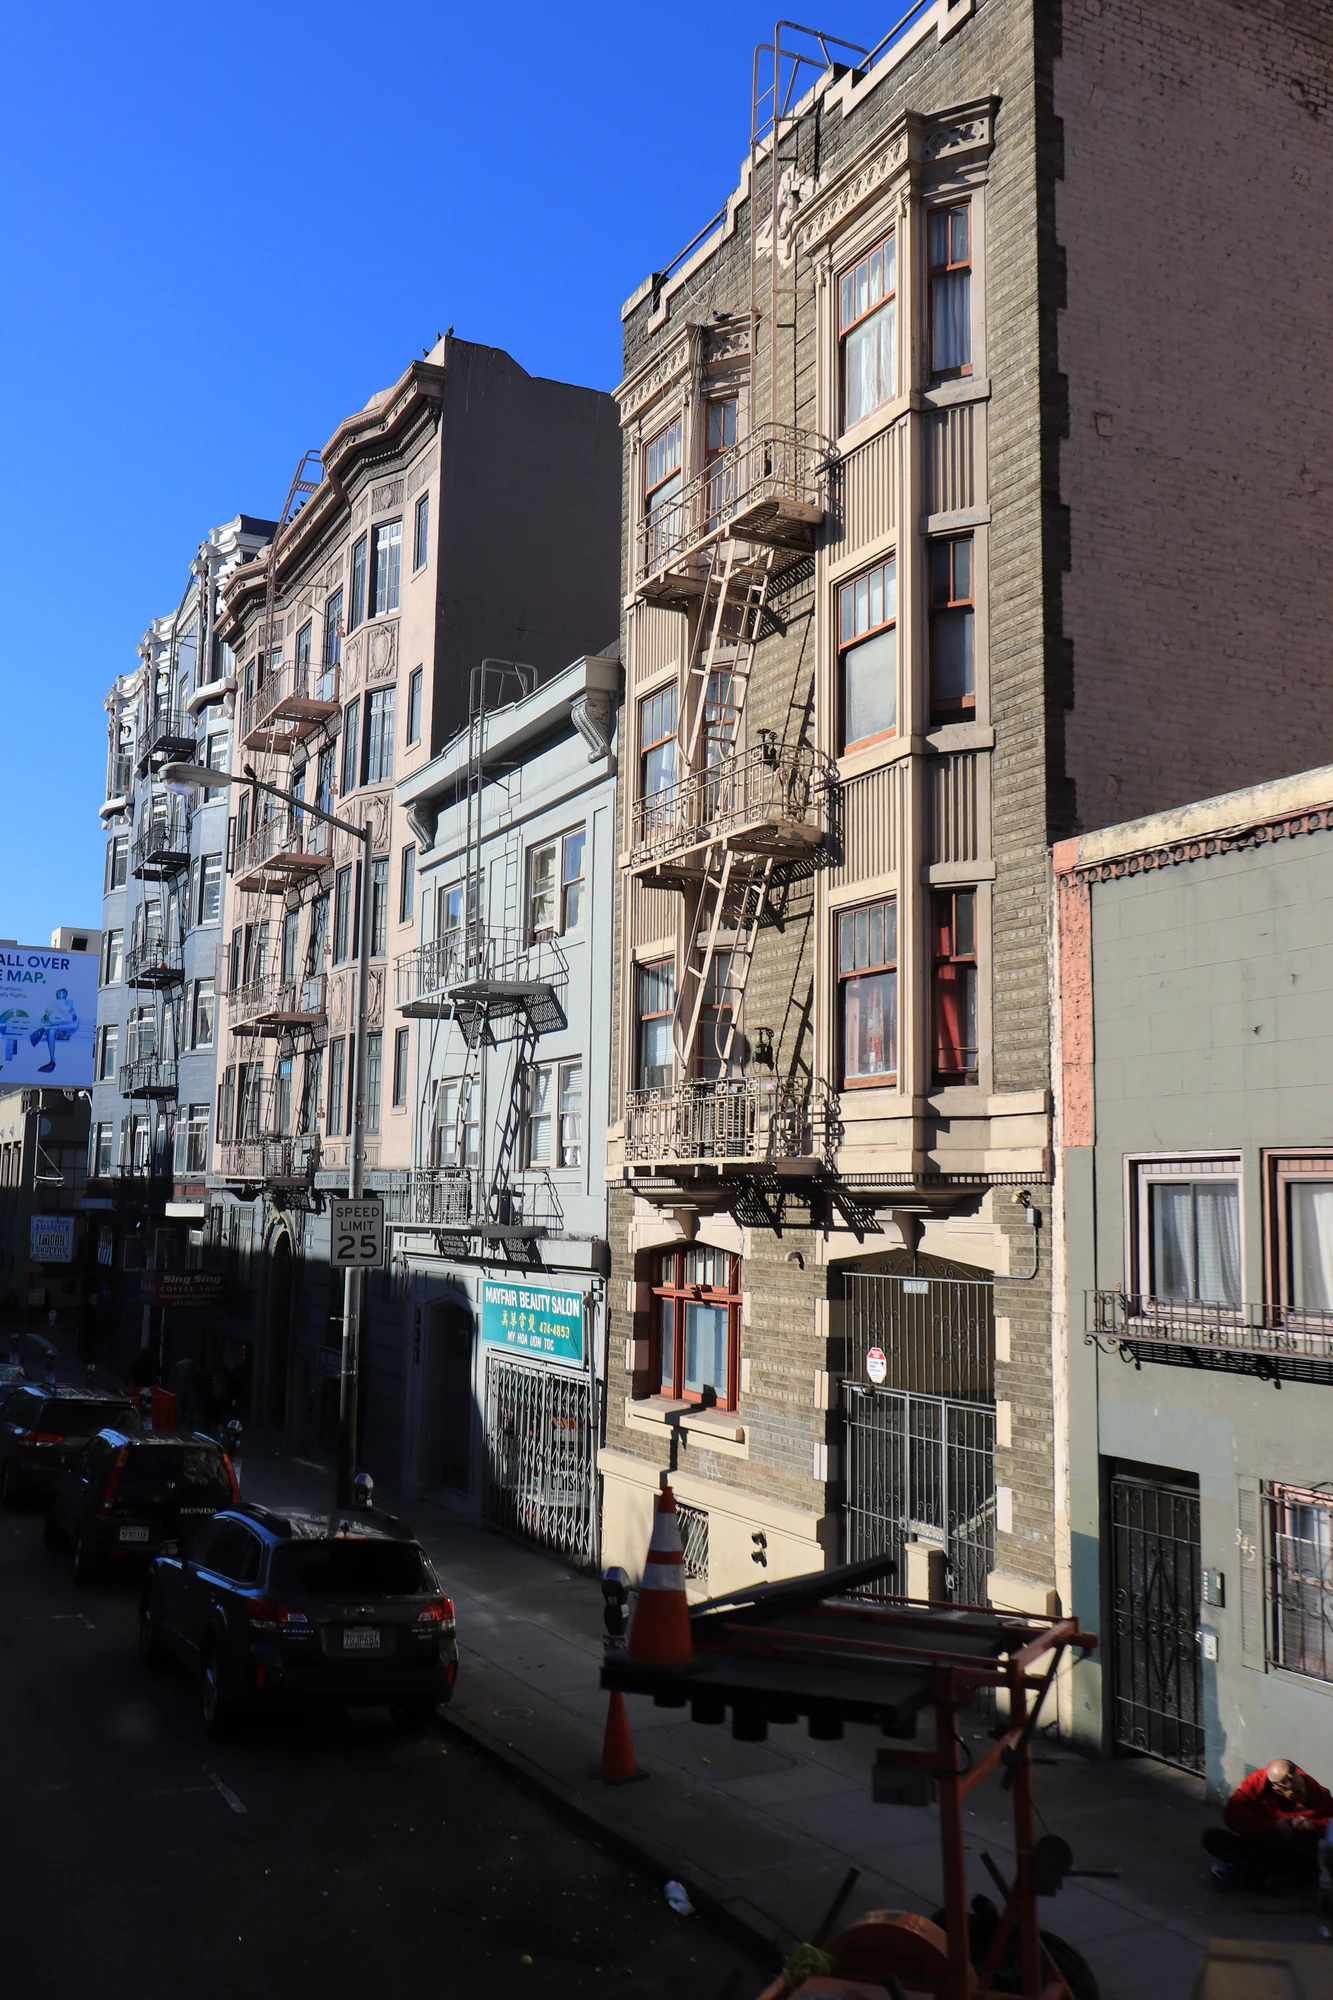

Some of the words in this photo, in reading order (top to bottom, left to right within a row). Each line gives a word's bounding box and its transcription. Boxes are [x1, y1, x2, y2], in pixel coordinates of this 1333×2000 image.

[27, 956, 70, 970] OVER
[7, 969, 46, 984] MAP.
[336, 1207, 379, 1218] SPEED
[340, 1221, 374, 1231] LIMIT
[38, 1233, 65, 1247] LIQUOR
[337, 1235, 377, 1259] 25
[163, 1274, 191, 1285] Sing
[193, 1274, 222, 1285] Sing
[485, 1286, 518, 1307] MAYFAIR
[519, 1291, 550, 1312] BEAUTY
[551, 1295, 580, 1317] SALON
[539, 1321, 570, 1340] 474-4853
[507, 1331, 516, 1342] MY
[517, 1332, 528, 1345] HOA
[551, 1474, 582, 1492] CLOS
[1234, 1528, 1257, 1562] 345
